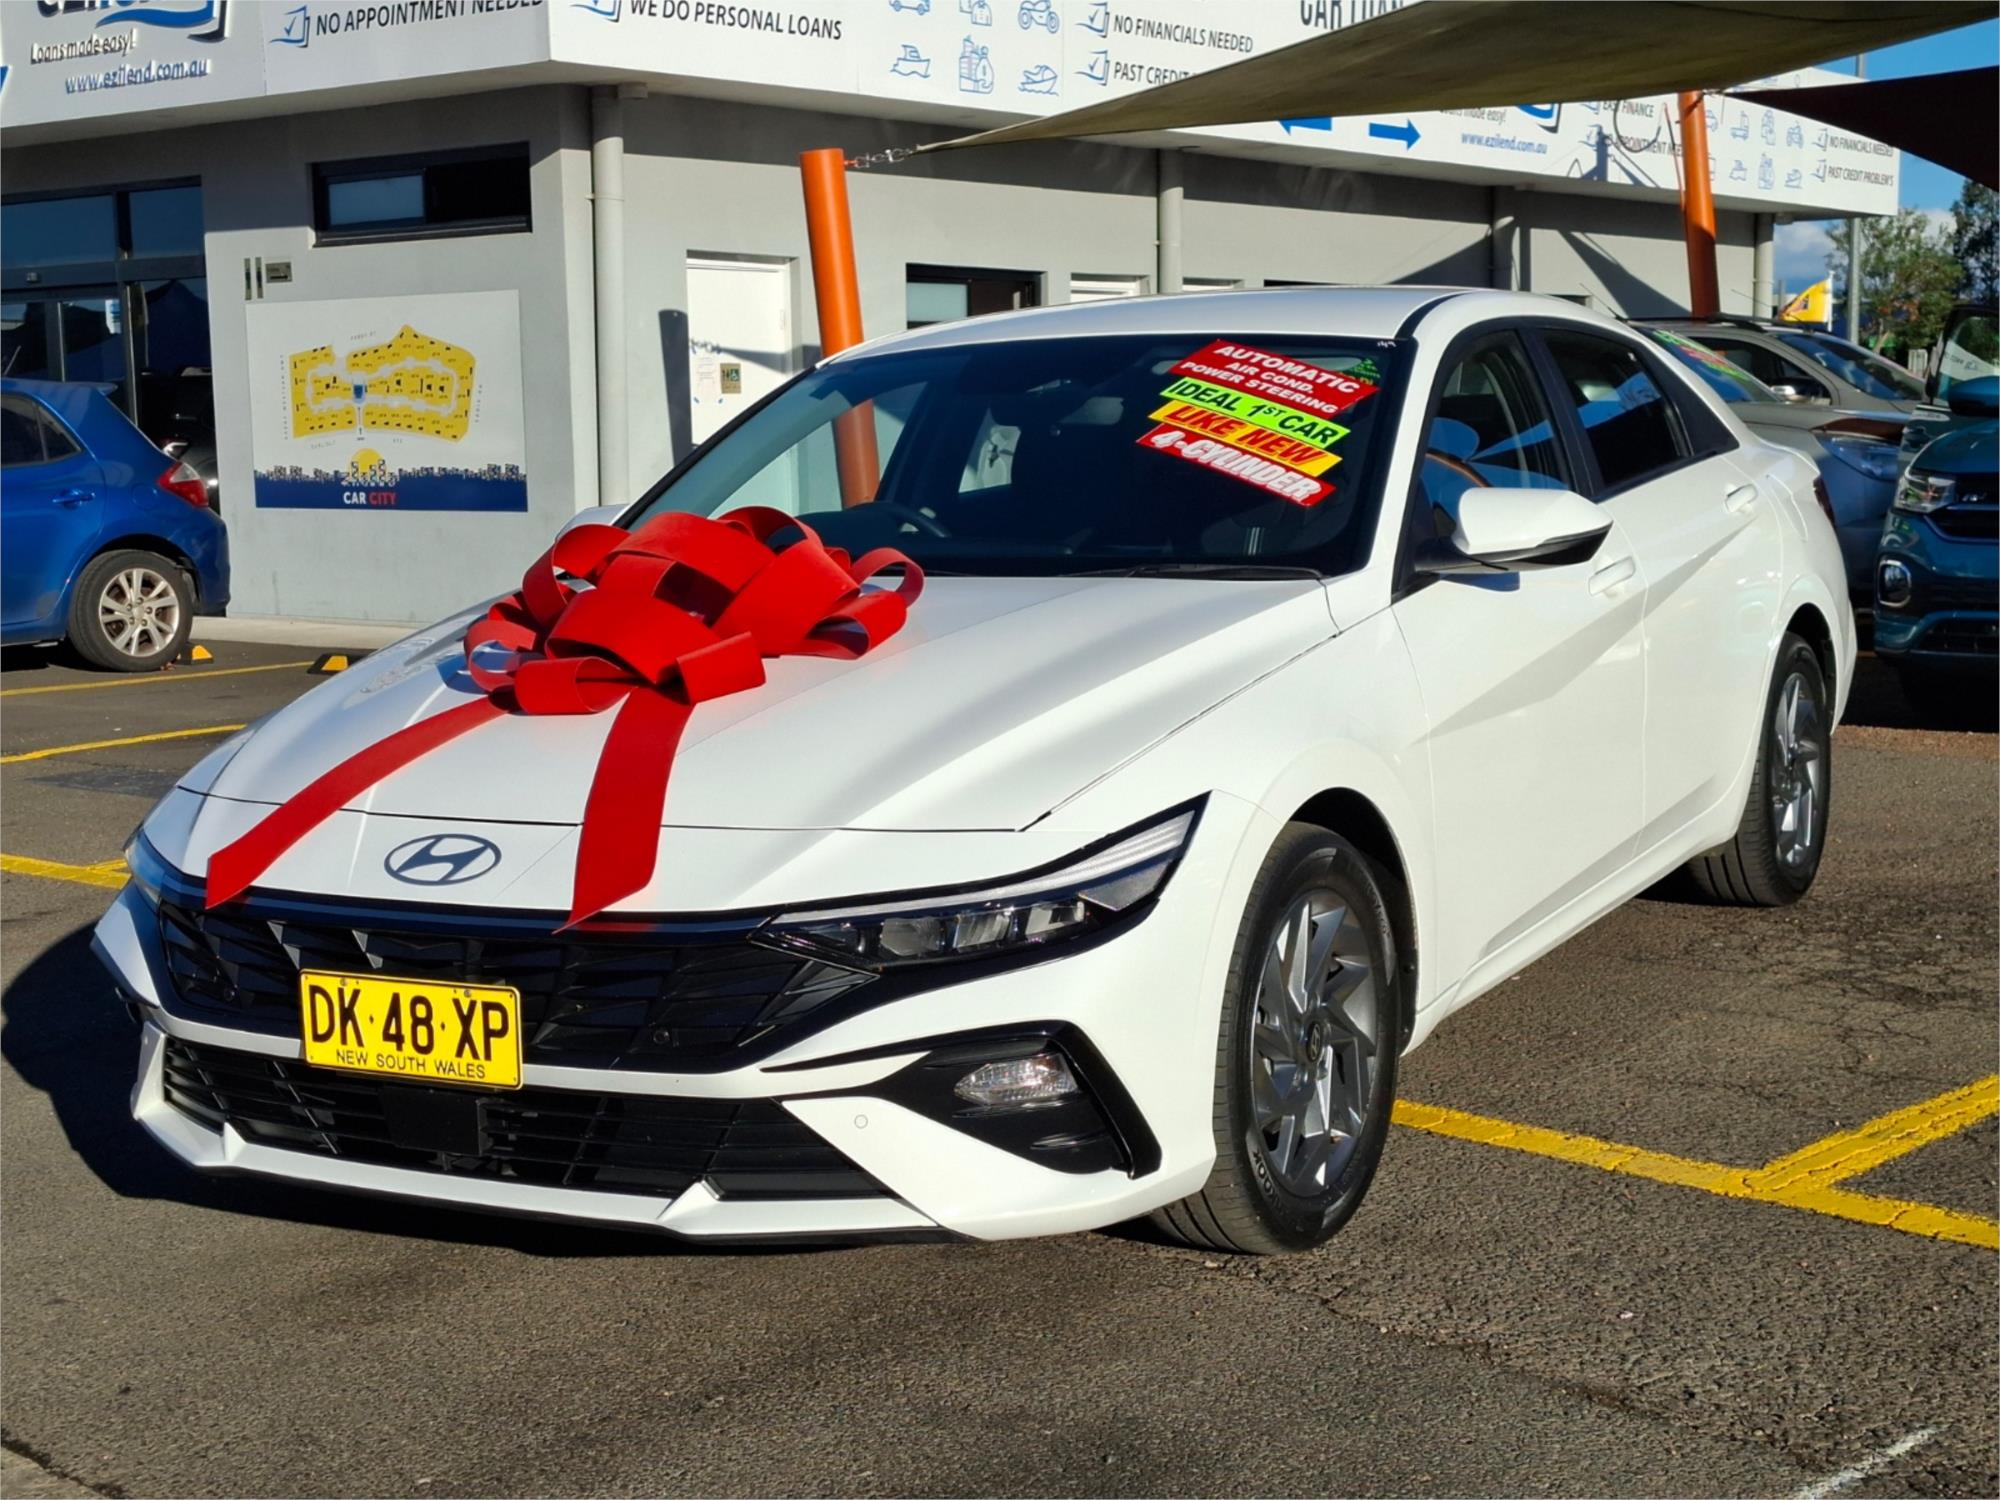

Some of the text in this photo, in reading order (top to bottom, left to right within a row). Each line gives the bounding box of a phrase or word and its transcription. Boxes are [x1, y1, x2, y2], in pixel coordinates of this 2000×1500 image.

[316, 0, 544, 36] NO APPOINTMENT NEE
[631, 0, 843, 41] WE DO PERSONAL LOANS
[1113, 14, 1254, 53] NO FINANCIALS NEEDED
[30, 28, 137, 65] Loans made easy!
[65, 59, 209, 94] www.ezilend.com.au
[1113, 61, 1145, 82] PAST
[1621, 100, 1655, 119] FINANCE
[1180, 361, 1339, 414] POWER STEERING
[1213, 345, 1361, 393] AUTOMATIC
[1225, 362, 1315, 394] AIR COND.
[1167, 380, 1242, 413] IDEAL
[1277, 414, 1340, 445] CAR
[1163, 404, 1330, 466] LIKE NEW
[1150, 429, 1322, 501] 4-CYLINDER
[343, 491, 397, 506] CAR CITY
[336, 1048, 486, 1080] NEW SOUTH WALES
